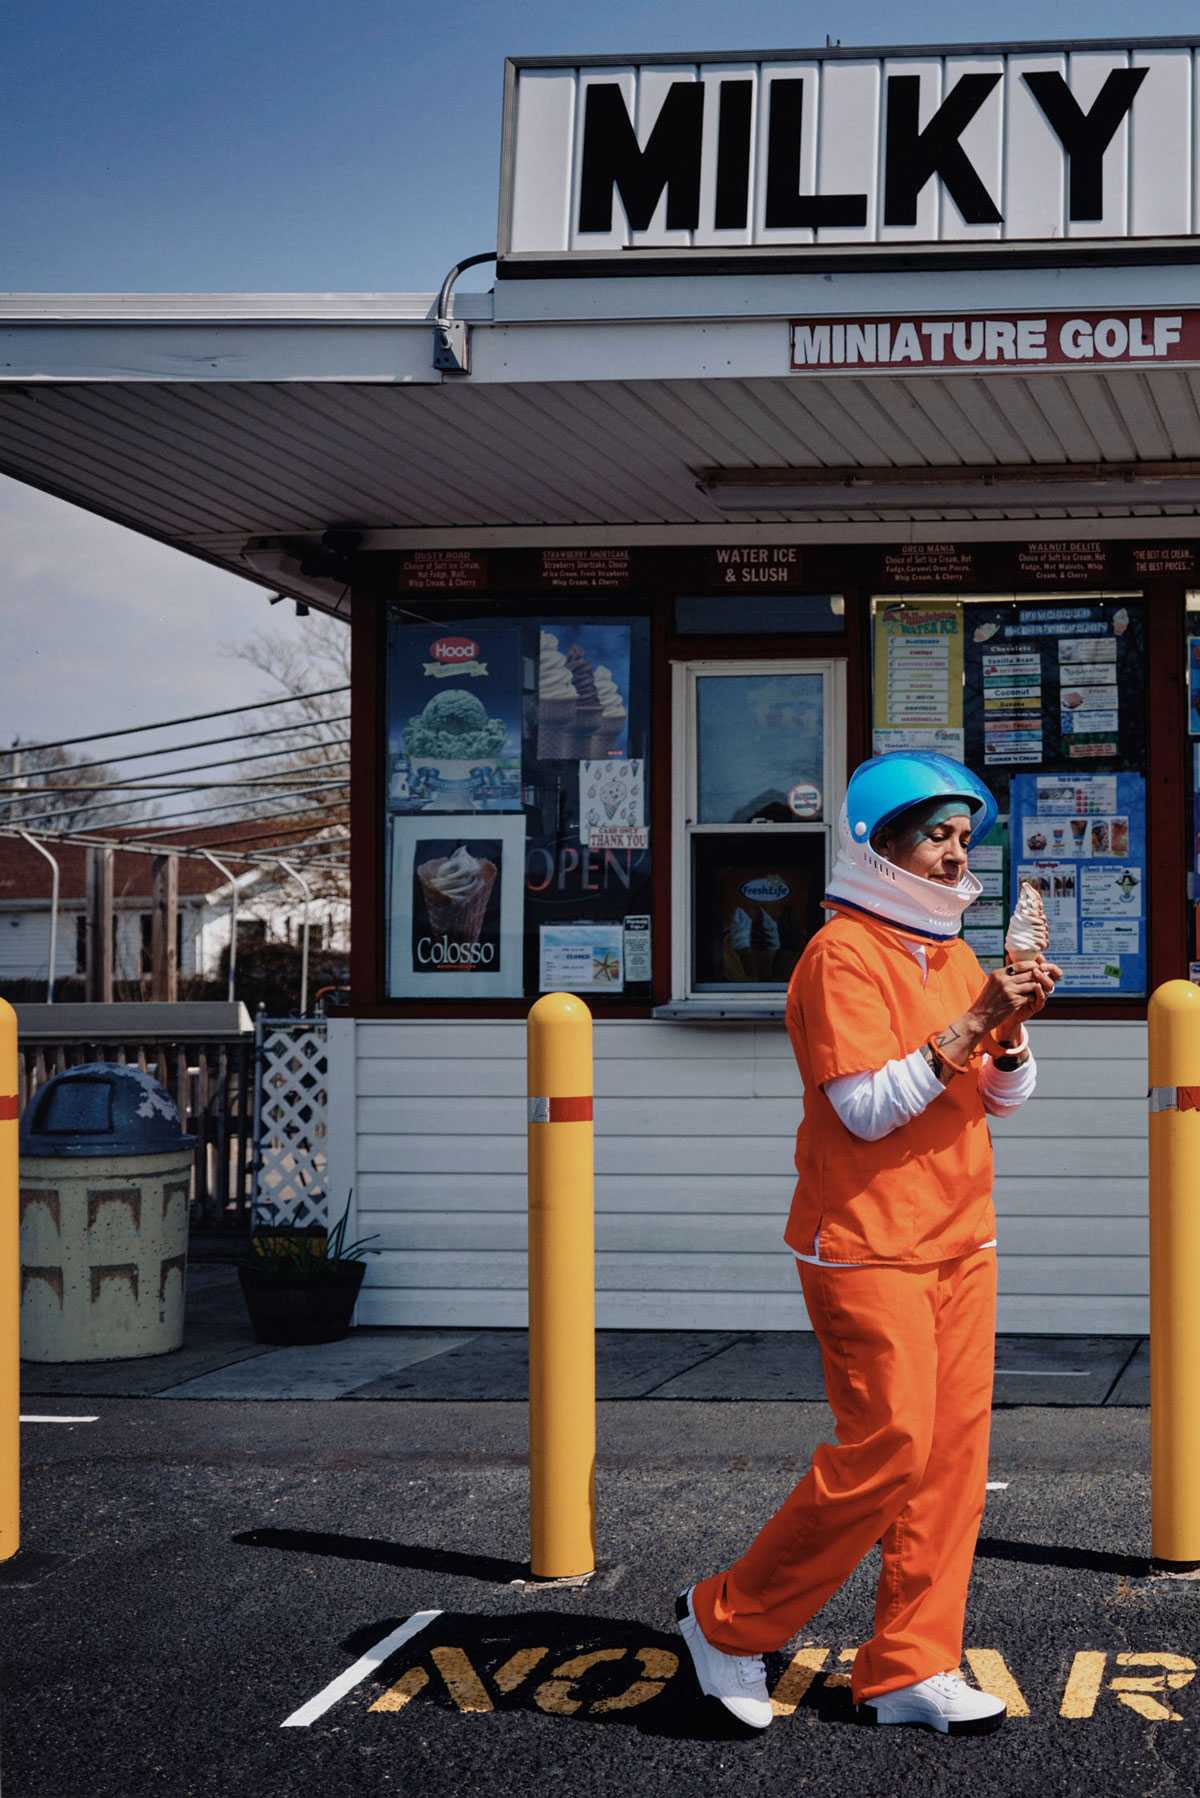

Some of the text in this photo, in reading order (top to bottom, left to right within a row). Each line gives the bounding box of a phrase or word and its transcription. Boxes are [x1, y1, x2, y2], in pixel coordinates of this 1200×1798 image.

[578, 67, 1149, 233] MILKY
[793, 316, 1183, 364] MINIATURE GOLF
[716, 549, 797, 563] WATER ICE
[725, 568, 788, 582] & SLUSH
[436, 643, 476, 657] Hood
[592, 834, 645, 846] THANK YOU
[527, 847, 633, 891] OPEN
[417, 935, 495, 964] Colosso
